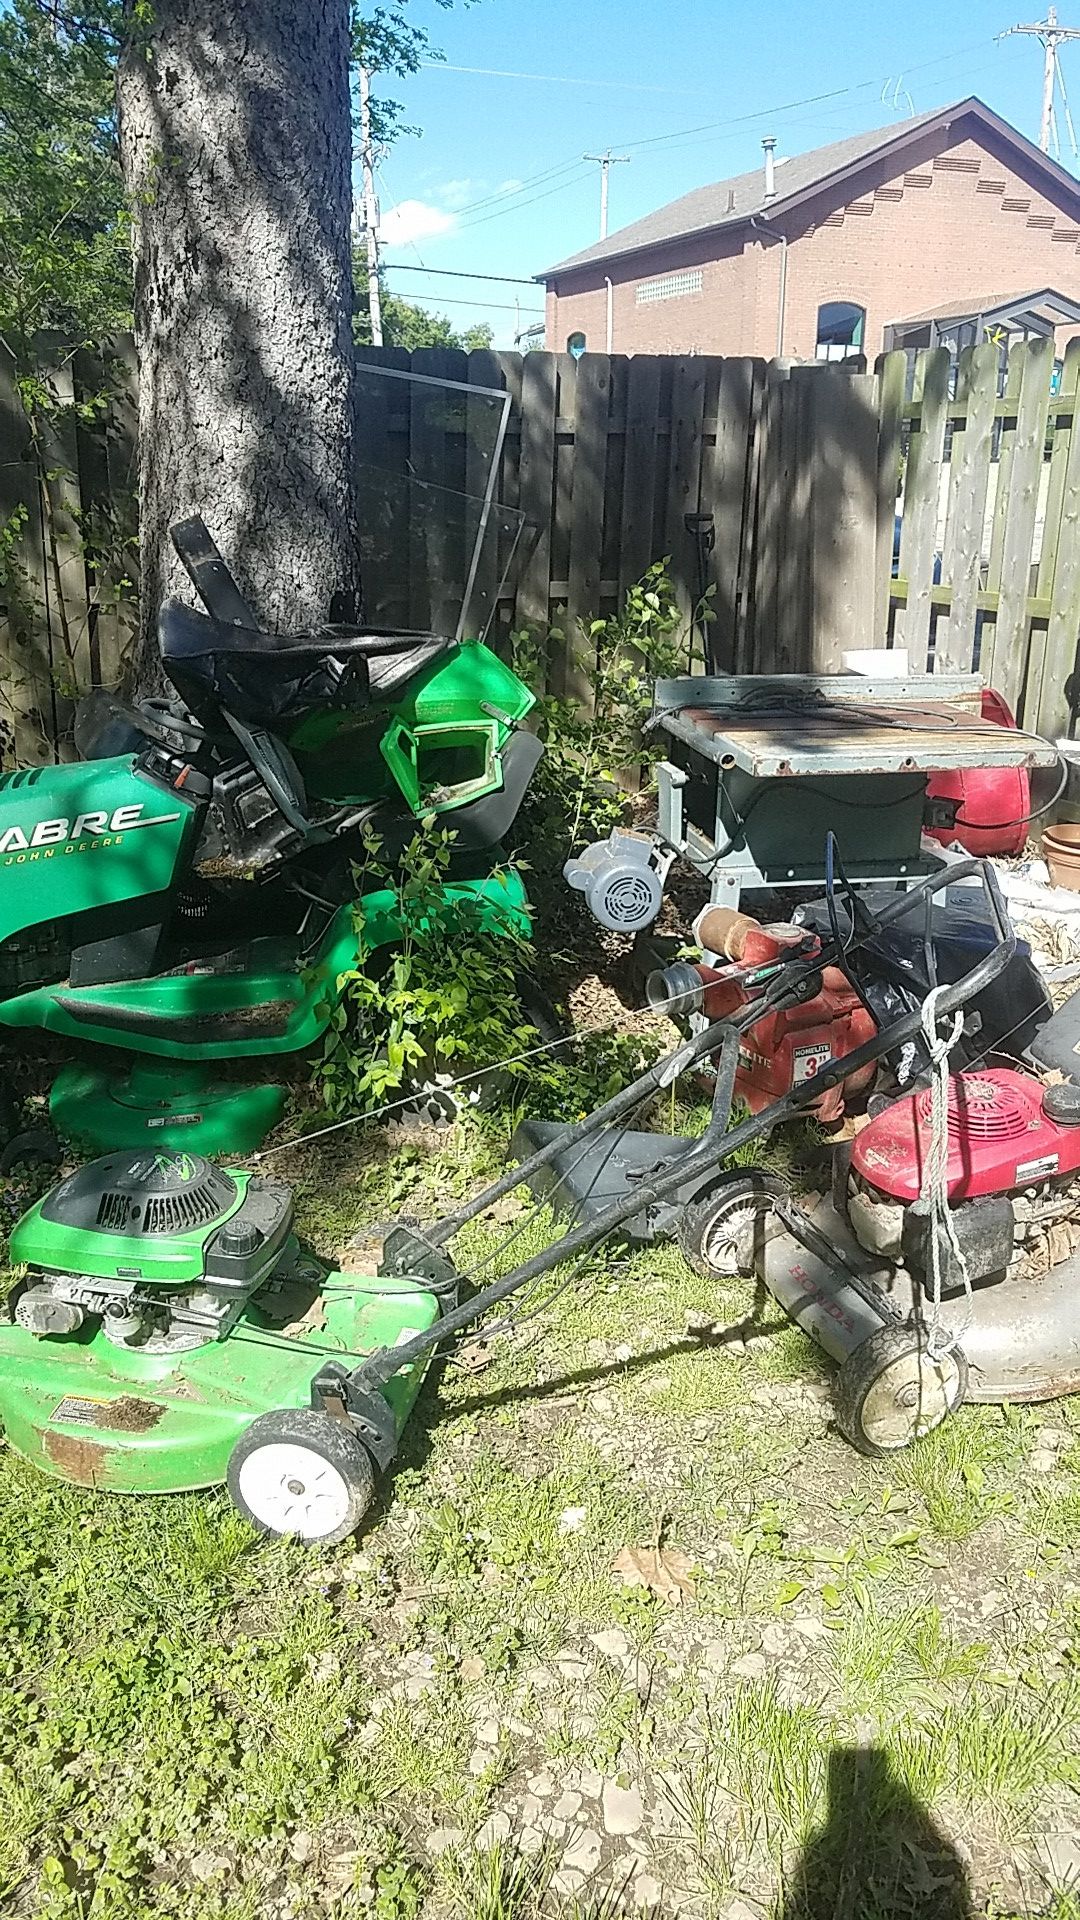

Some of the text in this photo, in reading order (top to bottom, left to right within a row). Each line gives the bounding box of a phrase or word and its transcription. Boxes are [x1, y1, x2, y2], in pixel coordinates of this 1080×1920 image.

[5, 834, 125, 866] JOHN DEERE
[794, 1044, 831, 1058] HOMELITE
[787, 1263, 855, 1335] HONDA
